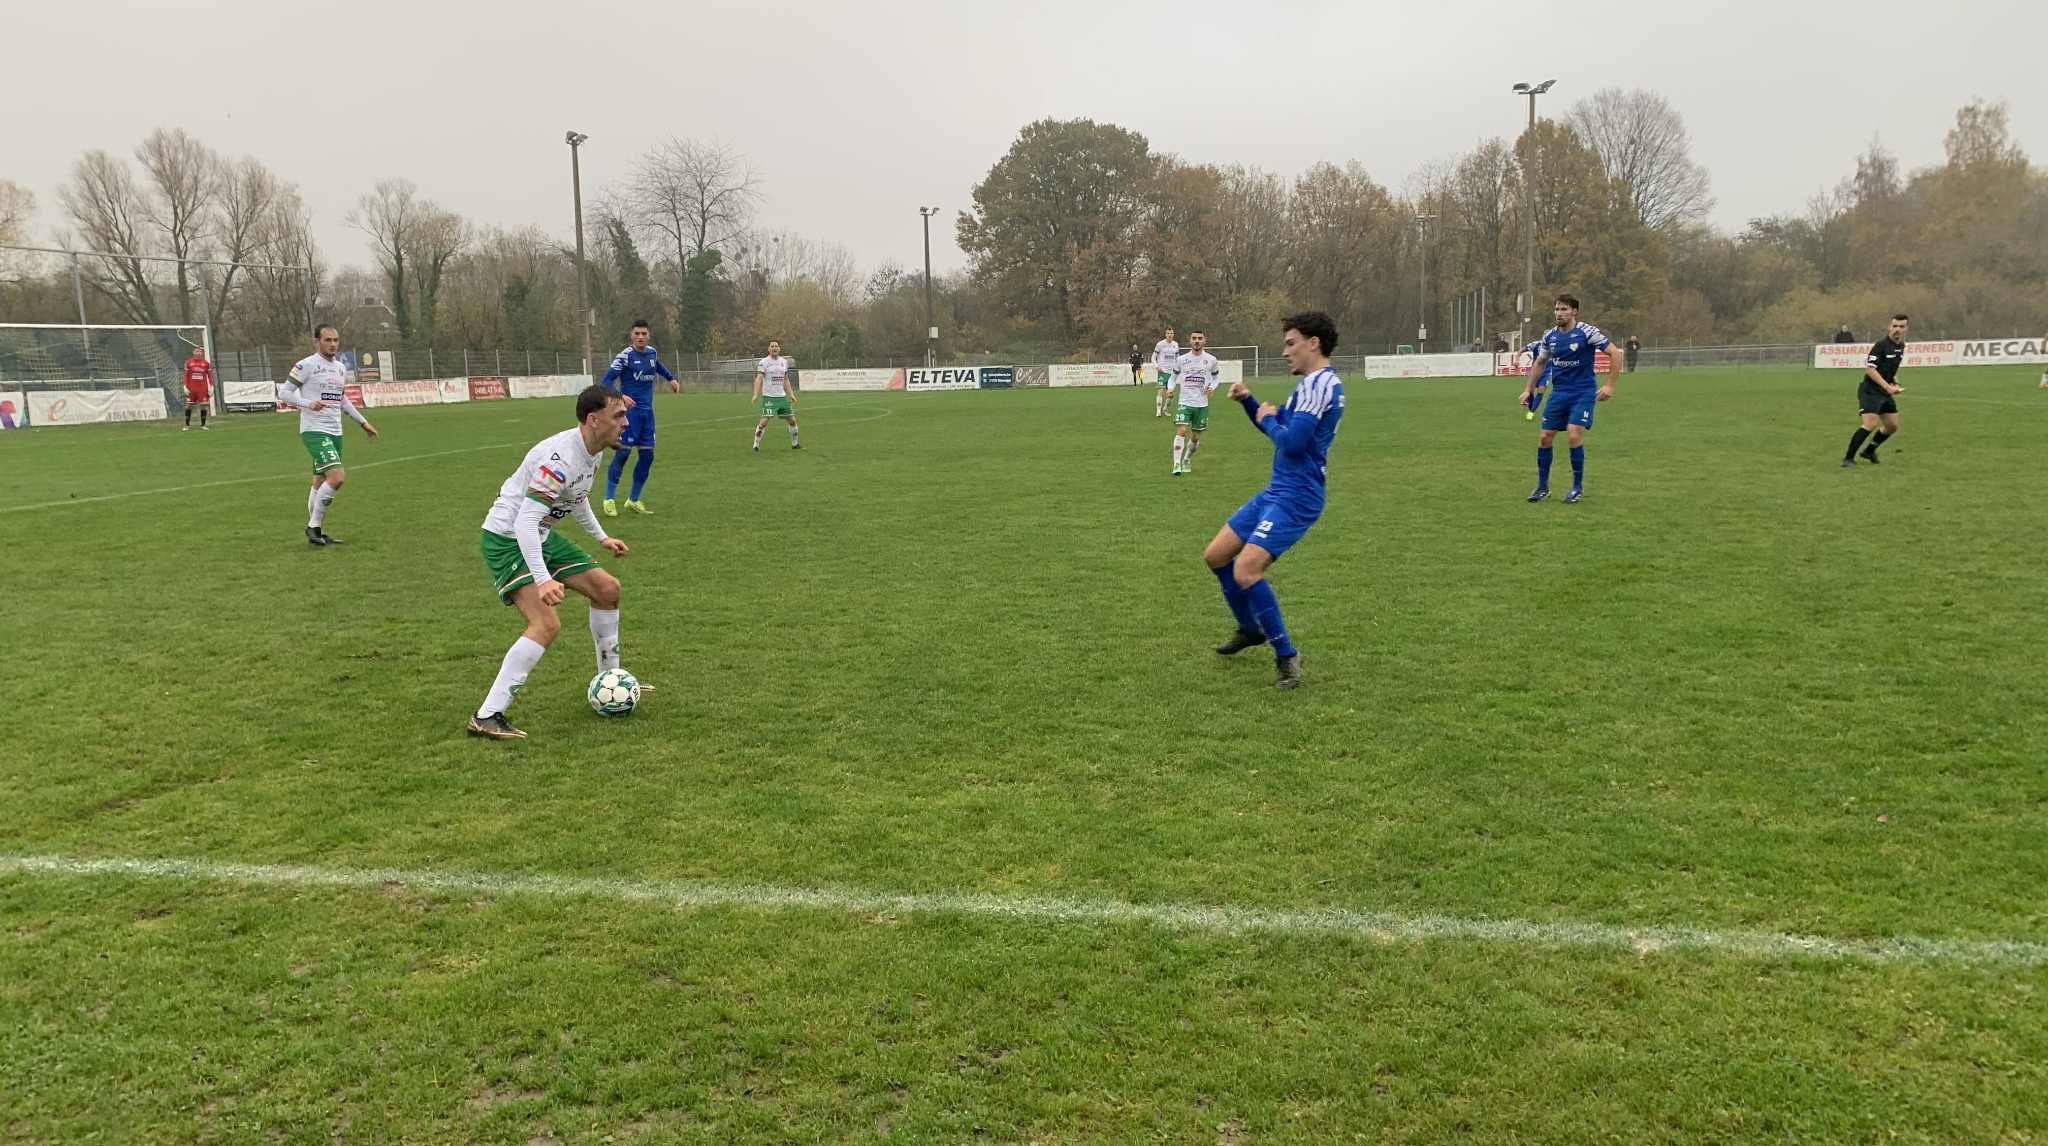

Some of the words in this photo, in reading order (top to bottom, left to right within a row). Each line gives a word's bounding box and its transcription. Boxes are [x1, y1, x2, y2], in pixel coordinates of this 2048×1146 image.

[1819, 345, 1872, 356] ASSURAN
[1904, 342, 1955, 354] ERNERO
[909, 369, 976, 384] ELTEVA
